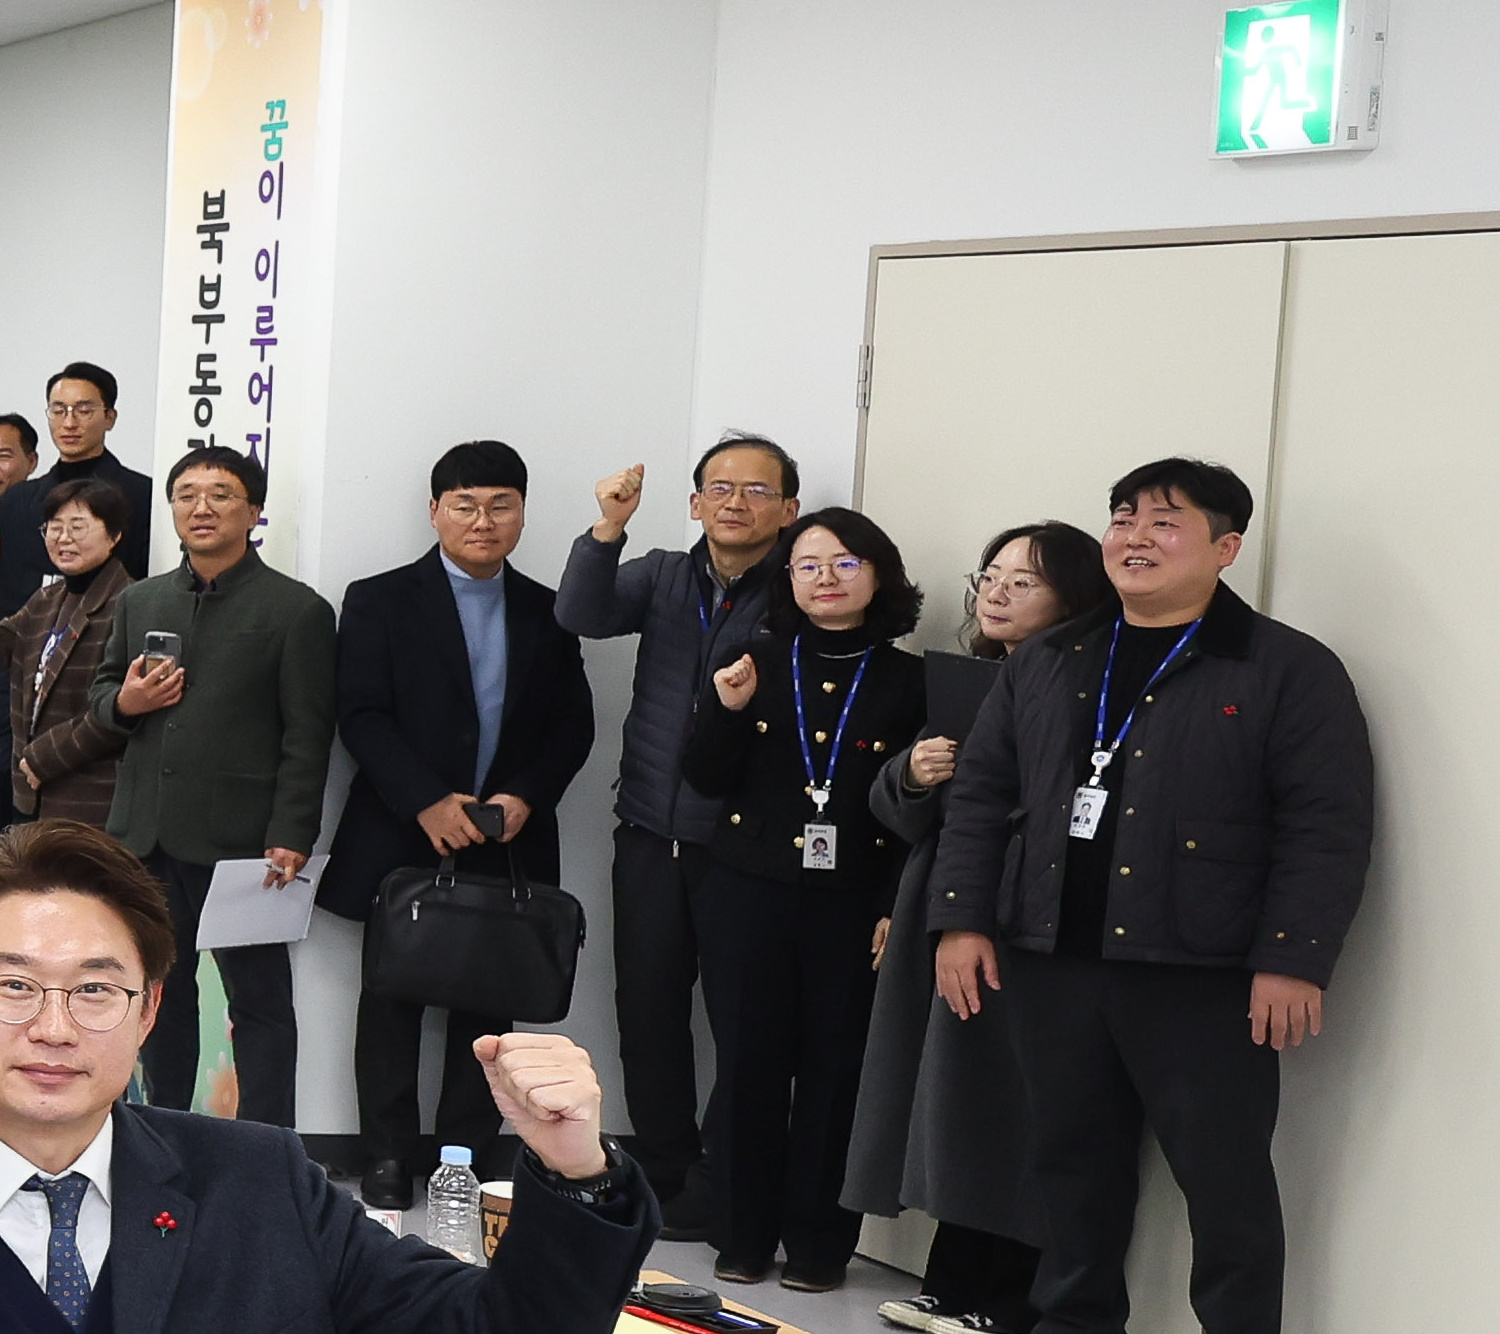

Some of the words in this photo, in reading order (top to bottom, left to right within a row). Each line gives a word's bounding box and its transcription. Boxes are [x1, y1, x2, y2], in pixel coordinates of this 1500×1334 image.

[260, 99, 289, 221] 꿈이
[186, 189, 230, 449] 북부동
[243, 239, 280, 547] 이루어지
